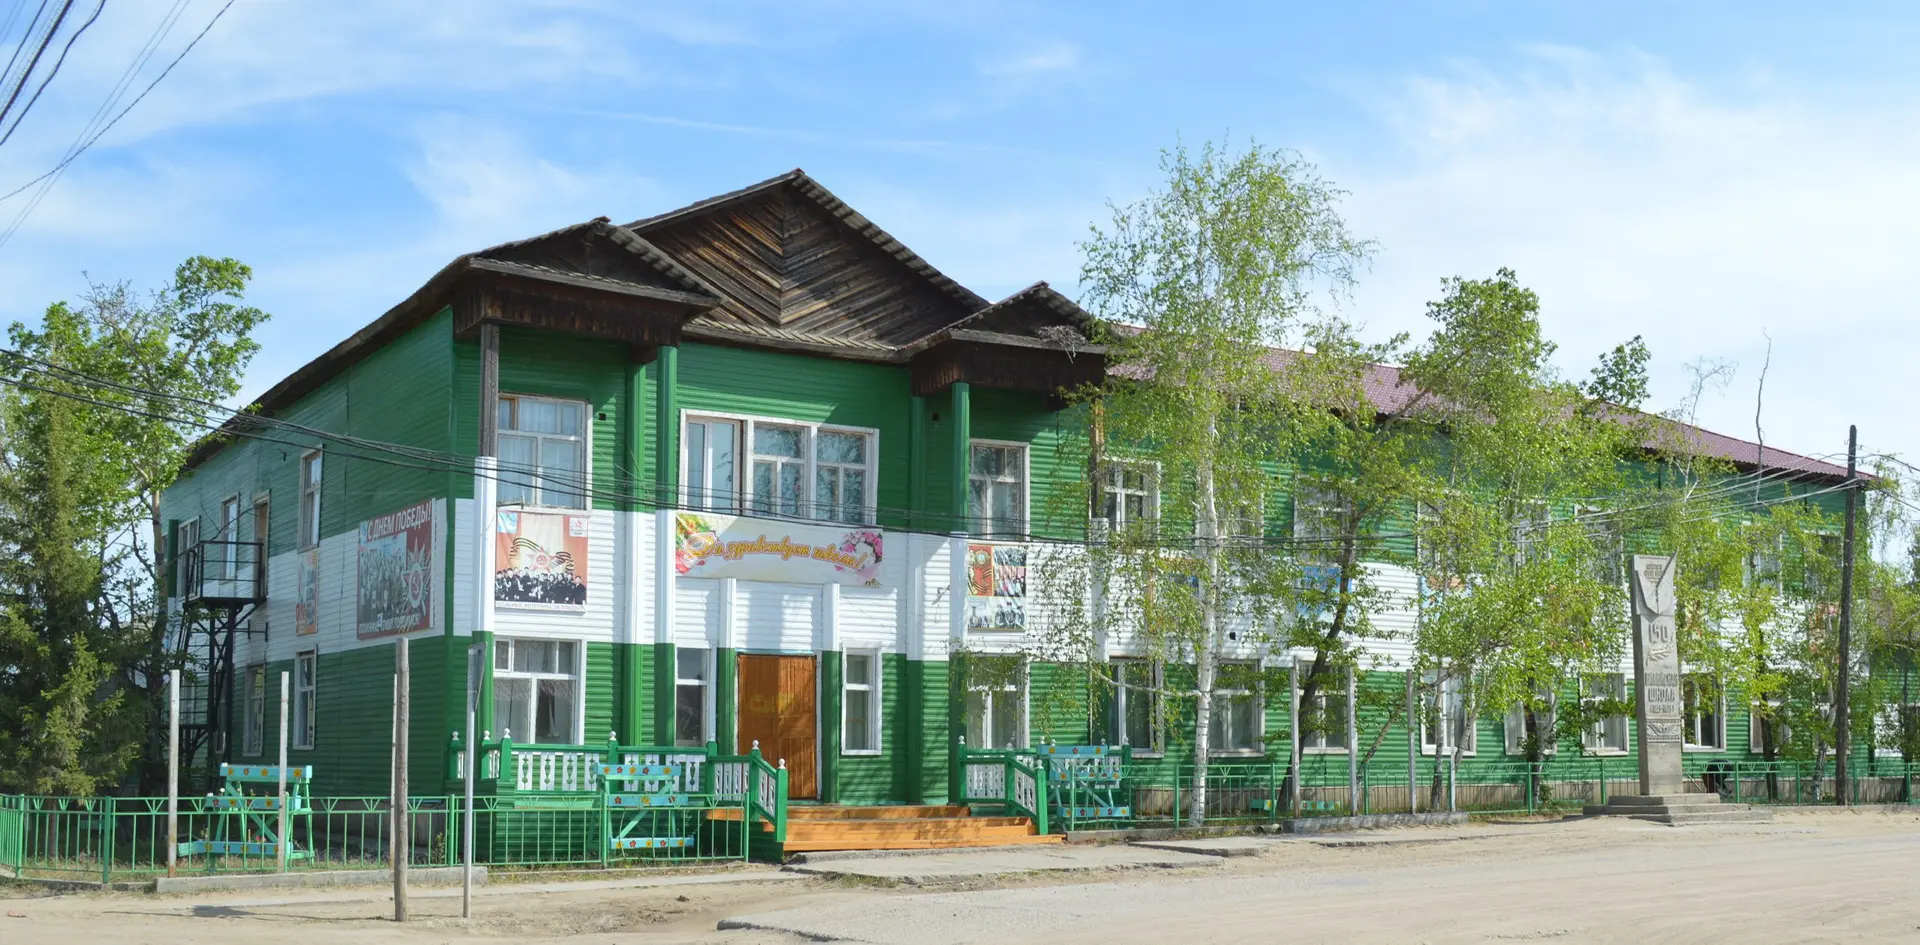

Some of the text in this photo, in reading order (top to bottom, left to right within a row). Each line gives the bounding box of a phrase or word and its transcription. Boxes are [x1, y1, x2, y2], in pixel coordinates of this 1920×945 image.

[367, 501, 432, 540] С ДНЕМ ПОБЕДЫ!
[1648, 623, 1668, 643] 150
[1648, 687, 1675, 702] ШКОЛА
